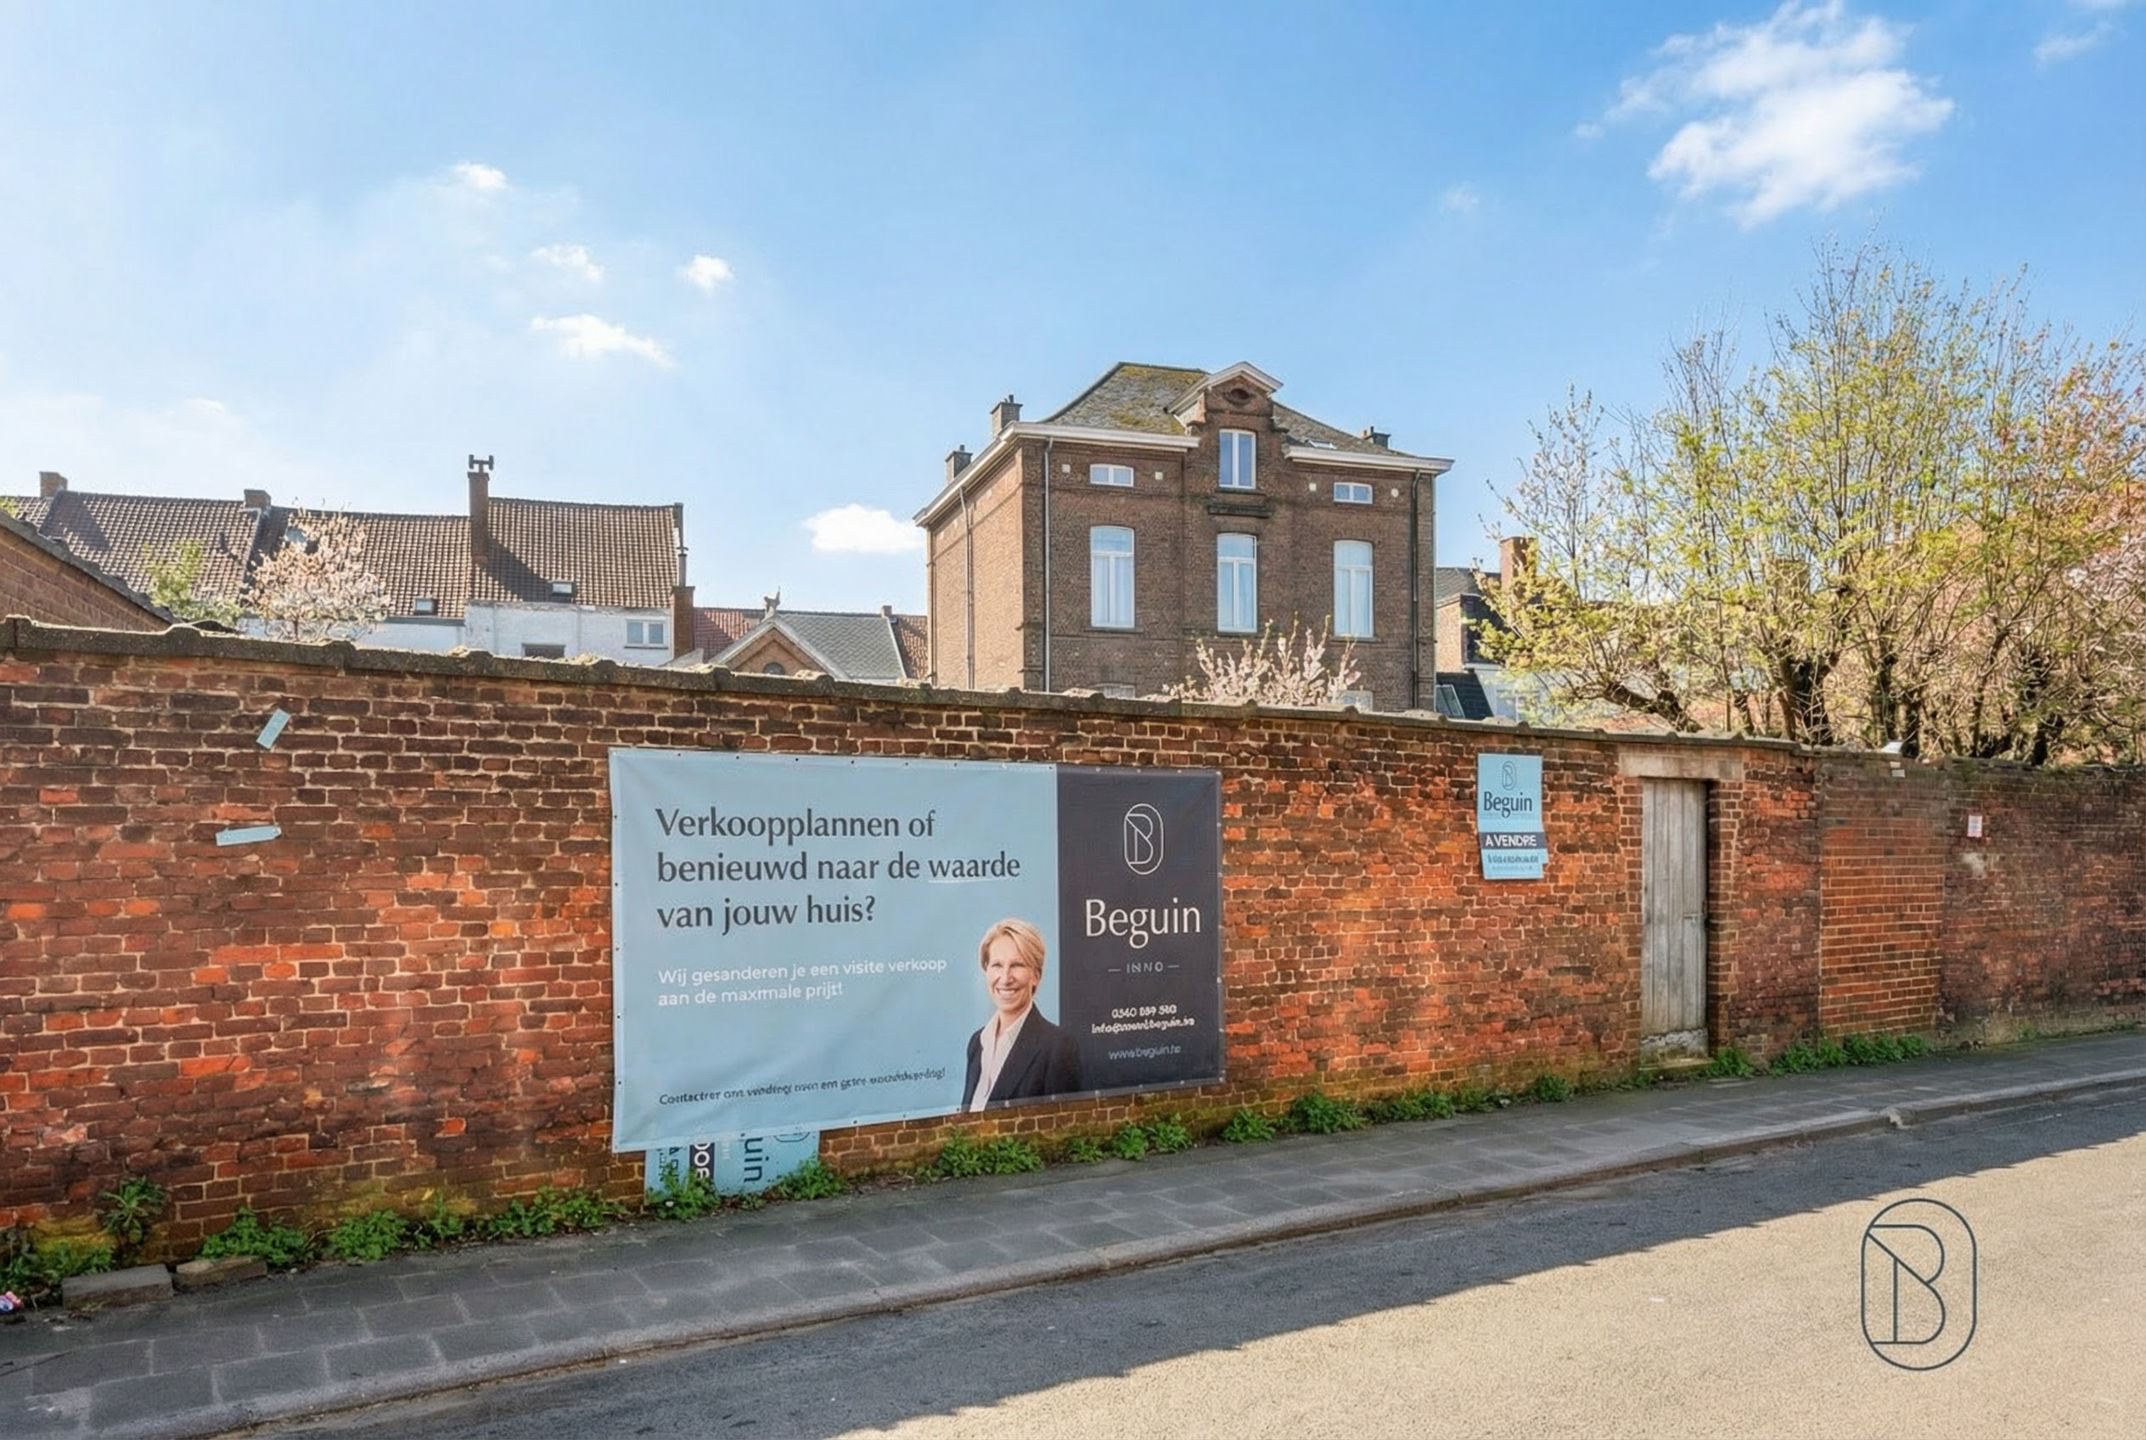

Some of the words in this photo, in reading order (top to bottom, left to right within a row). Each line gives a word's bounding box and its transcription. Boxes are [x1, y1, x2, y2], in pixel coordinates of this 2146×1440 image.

[1484, 791, 1532, 818] Beguin
[655, 806, 899, 846] Verkoopplannen
[908, 810, 937, 838] of
[657, 852, 808, 883] benieuwd
[817, 858, 879, 880] naar
[888, 852, 920, 880] de
[929, 851, 1021, 879] waarde
[657, 905, 713, 928] van
[722, 898, 798, 936] jouw
[807, 895, 876, 925] huis?
[1085, 897, 1201, 949] Beguin
[658, 969, 688, 987] Wij
[791, 963, 806, 981] je
[810, 964, 839, 977] een
[843, 959, 885, 975] visite
[888, 957, 947, 974] verkoop
[658, 992, 689, 1007] aan
[695, 988, 717, 1004] de
